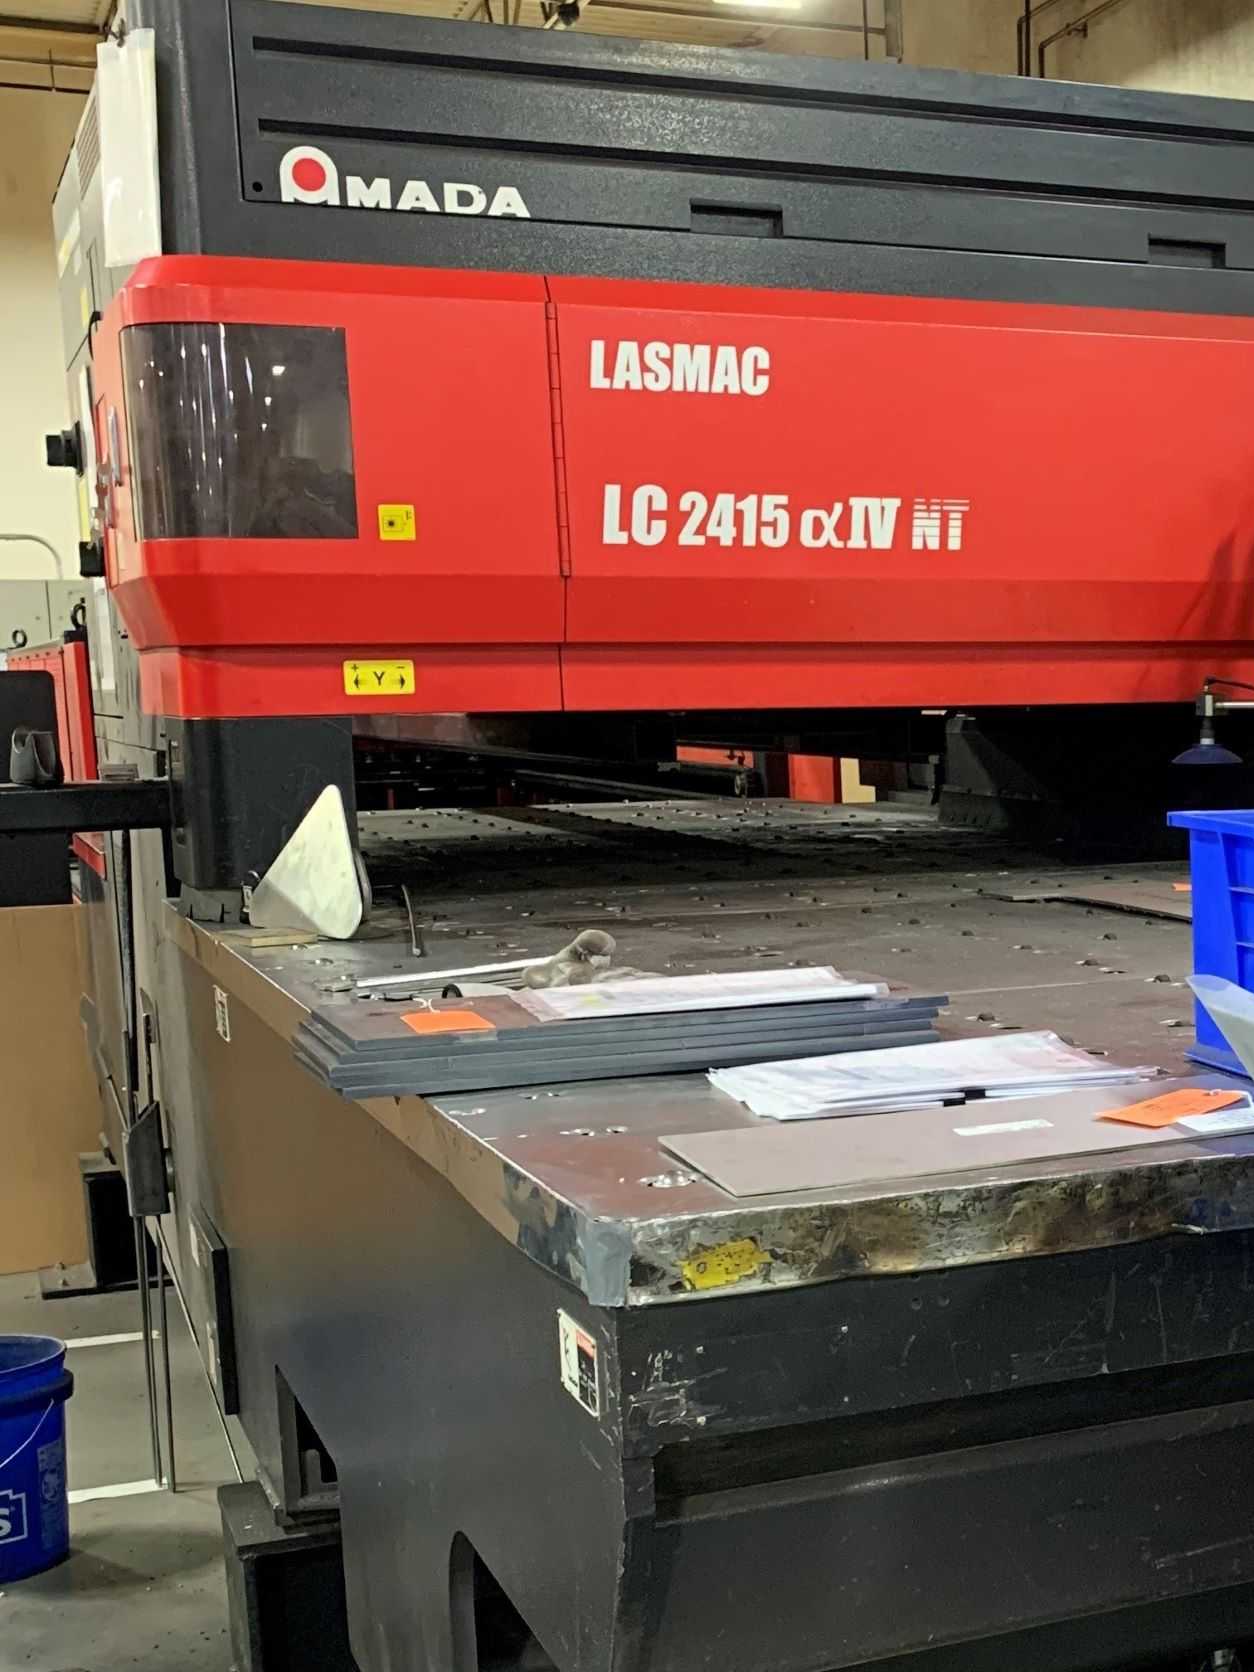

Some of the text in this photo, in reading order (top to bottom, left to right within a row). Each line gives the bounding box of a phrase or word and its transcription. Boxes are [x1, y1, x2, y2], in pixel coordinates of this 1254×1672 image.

[280, 146, 531, 218] AMADA
[590, 339, 770, 396] LASMAC
[602, 483, 668, 546] LC
[678, 490, 790, 548] 2415
[911, 498, 970, 550] NT
